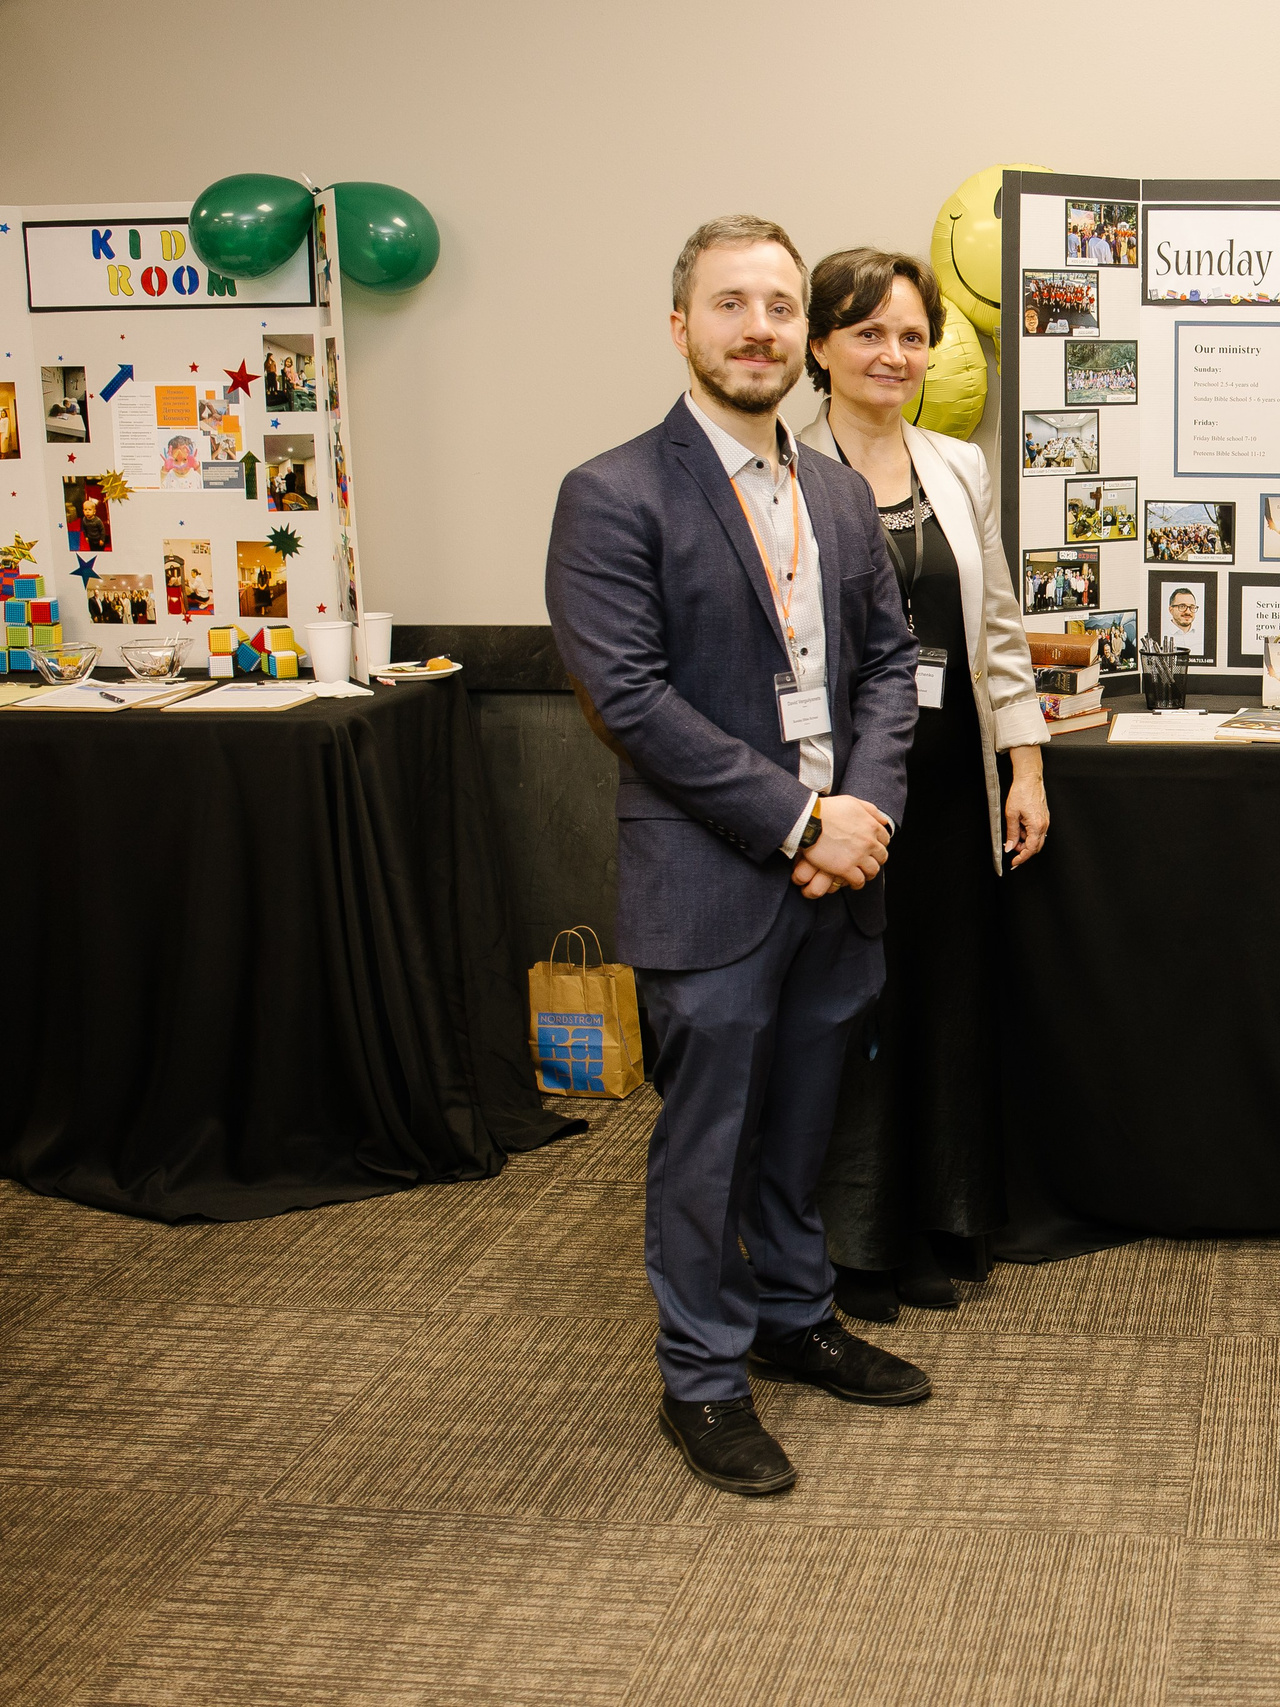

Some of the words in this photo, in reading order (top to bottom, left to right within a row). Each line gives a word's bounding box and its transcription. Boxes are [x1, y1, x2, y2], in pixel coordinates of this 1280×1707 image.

[92, 229, 187, 262] KID
[1155, 239, 1274, 287] Sunday
[107, 264, 237, 297] ROOM
[1194, 344, 1216, 354] Our
[1218, 344, 1262, 357] ministry
[1193, 366, 1222, 374] Sunday:
[1193, 419, 1219, 427] Friday:
[1255, 623, 1277, 631] grow
[540, 1015, 601, 1025] NORDSTROM
